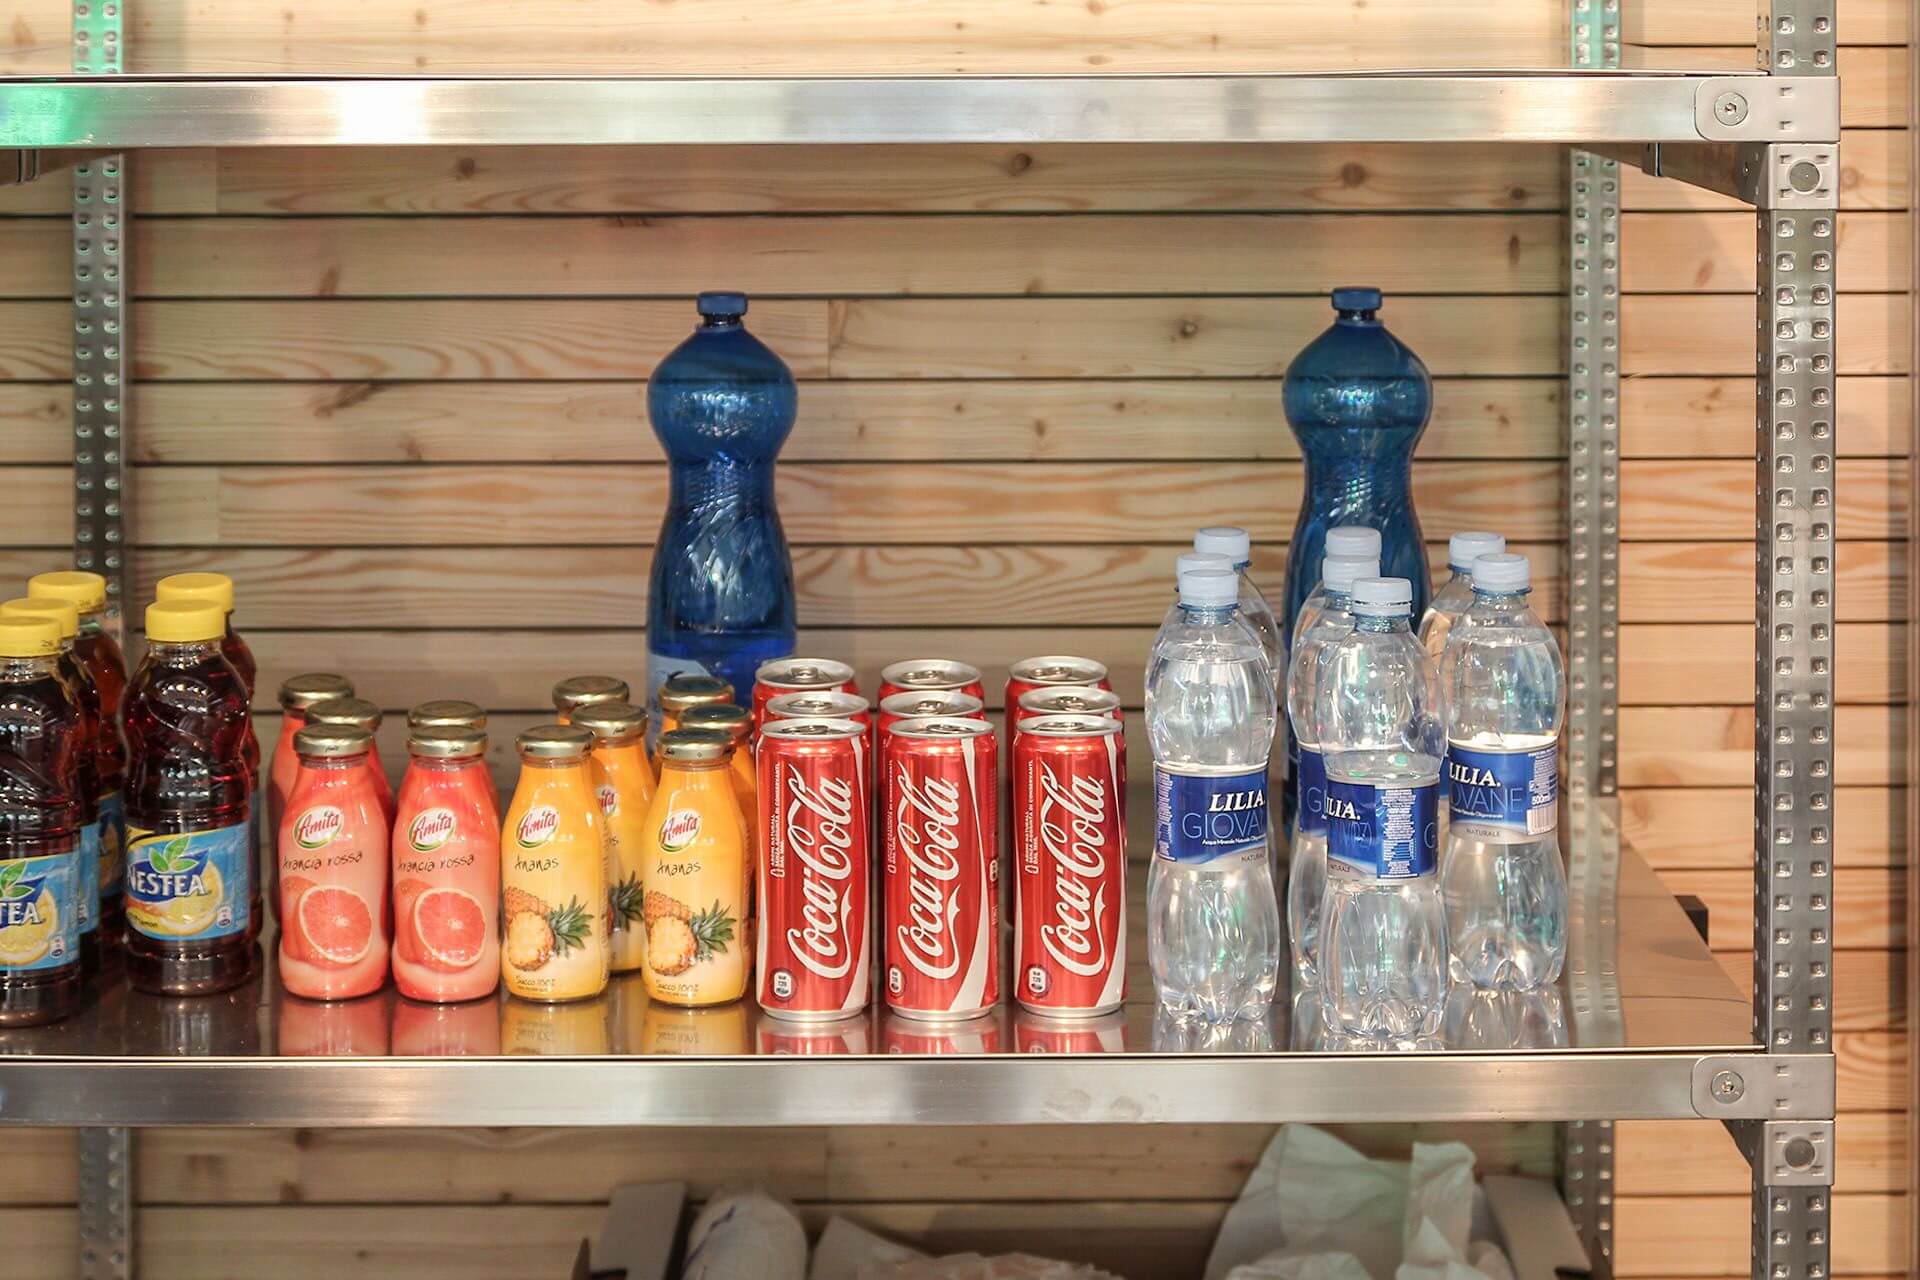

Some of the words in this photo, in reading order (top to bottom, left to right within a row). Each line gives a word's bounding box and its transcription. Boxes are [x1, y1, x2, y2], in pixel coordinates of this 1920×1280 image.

[299, 811, 339, 841] Amita
[413, 813, 452, 844] Amita
[519, 811, 557, 842] Amita
[662, 813, 699, 845] Amita
[327, 850, 363, 867] rossa
[440, 854, 475, 869] rossa
[788, 763, 852, 979] Coca-Cola
[898, 759, 961, 980] Coca-Cola
[1041, 759, 1106, 976] Coca-Cola
